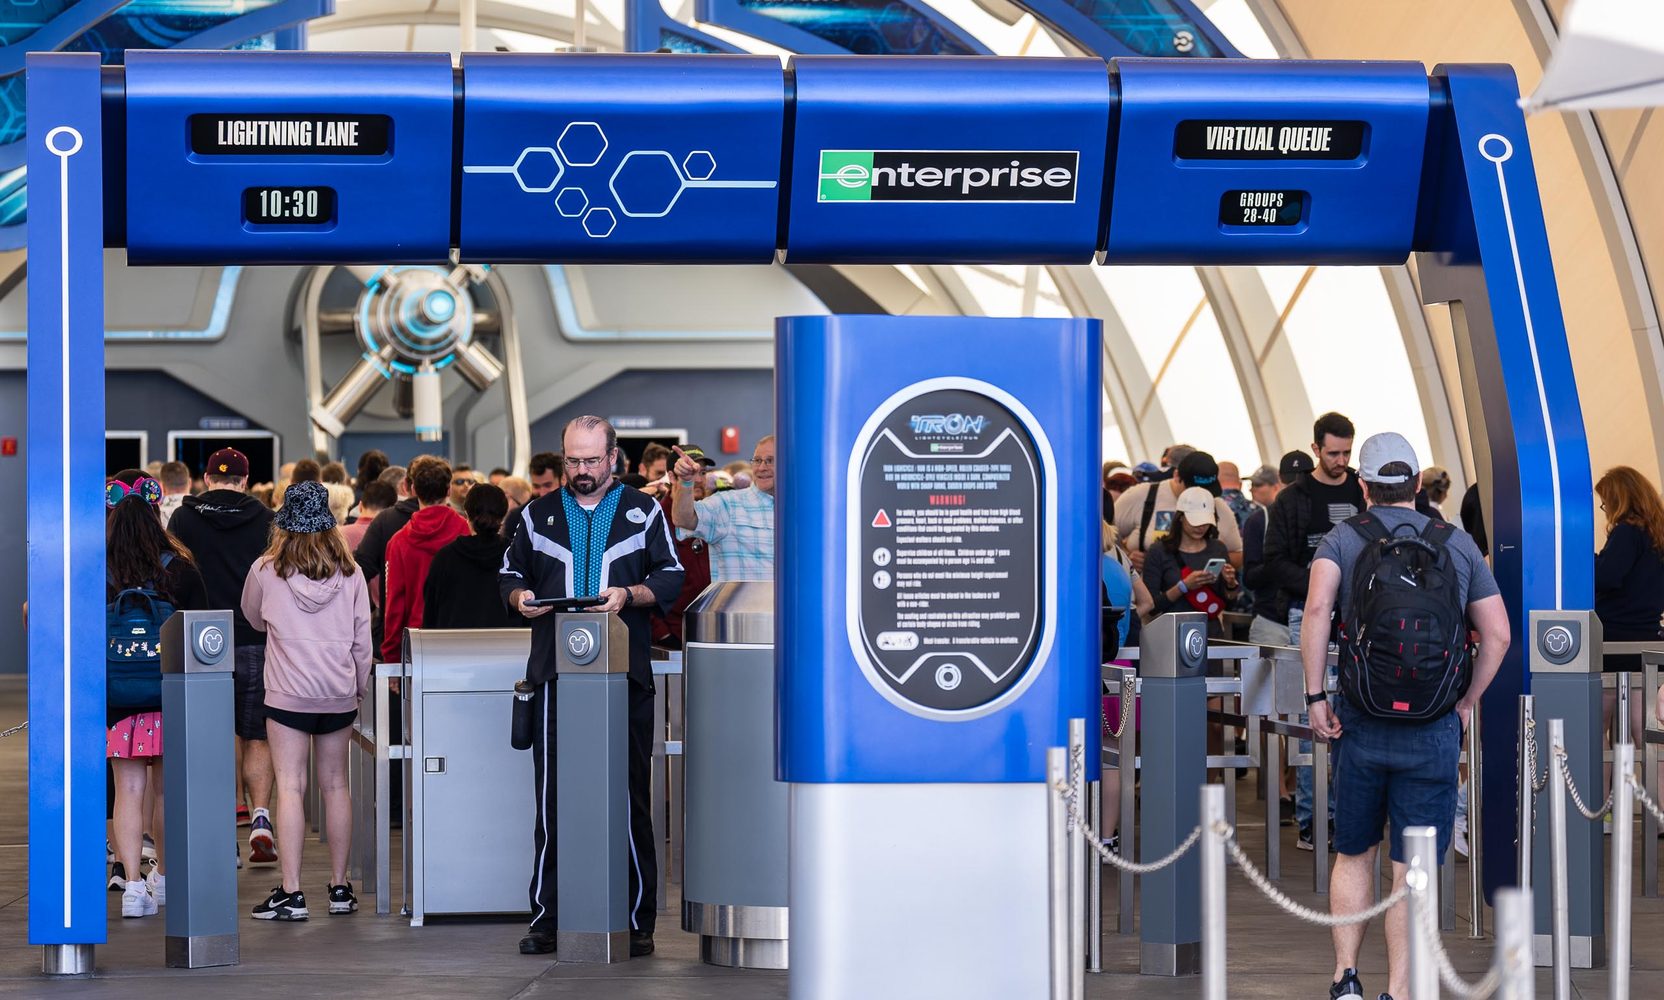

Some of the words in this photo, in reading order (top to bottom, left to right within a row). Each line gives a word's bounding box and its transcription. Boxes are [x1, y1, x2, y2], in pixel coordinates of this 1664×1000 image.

[217, 120, 312, 147] LIGHTNING
[316, 120, 359, 147] LANE
[1206, 126, 1274, 151] VIRTUAL
[1278, 126, 1333, 154] QUEUE
[835, 160, 1072, 194] enterprise
[260, 190, 318, 218] 10:30
[1239, 192, 1284, 208] GROUPS
[1243, 208, 1277, 223] 28-40
[910, 413, 984, 435] TRON
[930, 494, 966, 506] WARNING!
